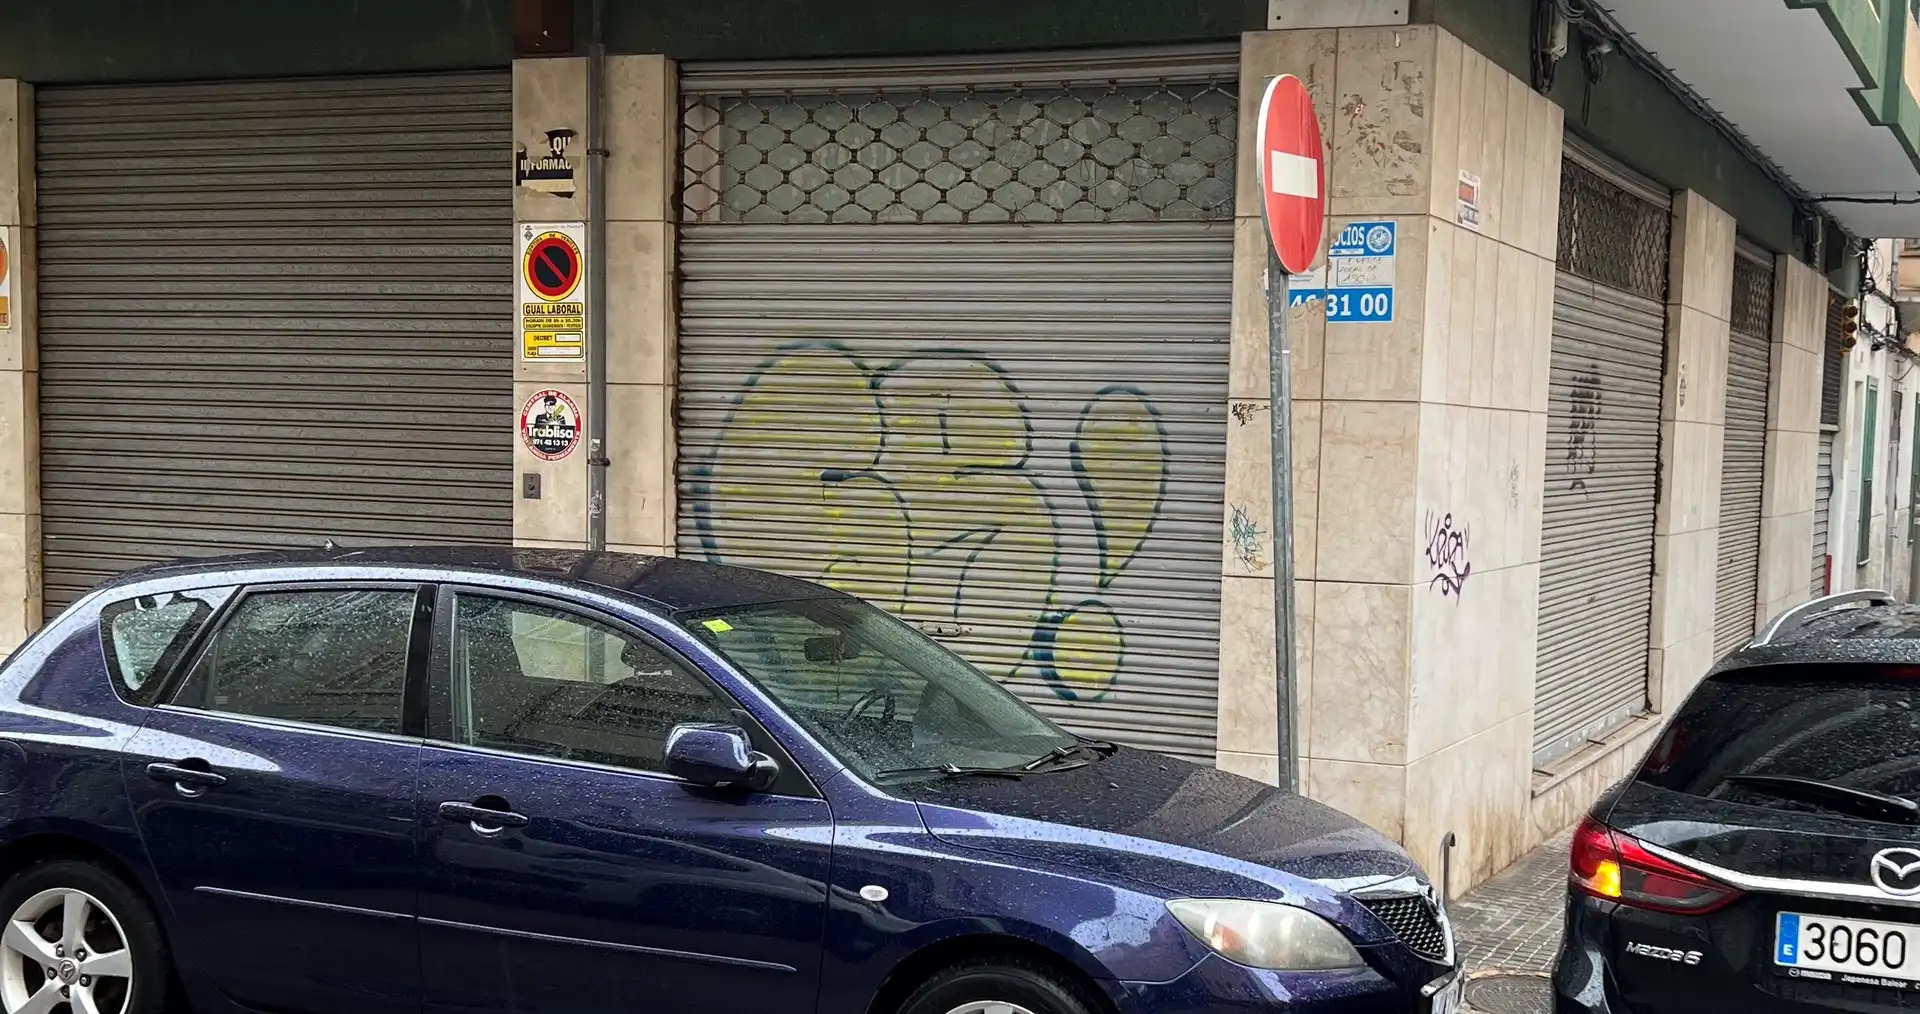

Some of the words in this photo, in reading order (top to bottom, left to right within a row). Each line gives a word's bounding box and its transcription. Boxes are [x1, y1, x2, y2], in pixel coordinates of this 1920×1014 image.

[525, 304, 546, 314] GUAL
[547, 304, 581, 314] LABORAL
[1326, 293, 1352, 316] 31
[1360, 293, 1389, 316] 00
[522, 391, 548, 417] CENTRAL
[558, 392, 579, 419] ALARMA
[526, 425, 574, 439] Trablisa
[1783, 944, 1793, 956] E
[1803, 922, 1907, 969] 3060
